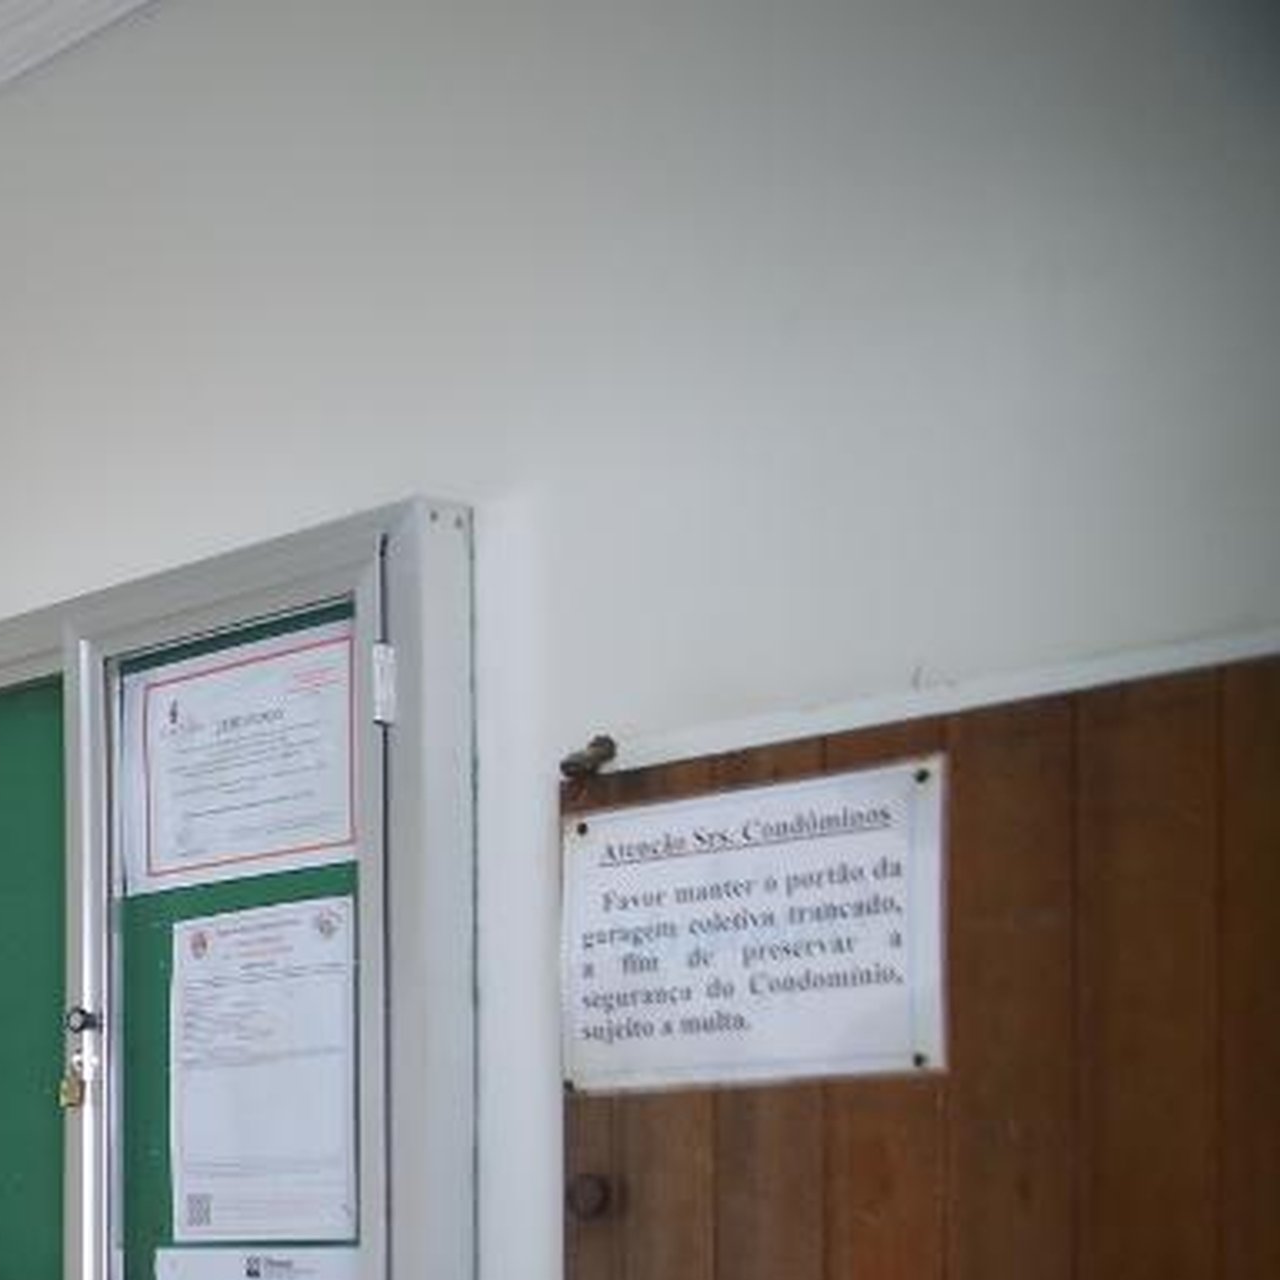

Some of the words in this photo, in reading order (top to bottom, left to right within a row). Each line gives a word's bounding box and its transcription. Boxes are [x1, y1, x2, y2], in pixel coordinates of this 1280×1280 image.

[600, 832, 687, 865] Atenção
[601, 885, 668, 912] Favor
[673, 877, 756, 904] manter
[763, 873, 779, 892] o
[784, 862, 865, 897] portão
[871, 855, 903, 880] da
[581, 922, 678, 949] garagem
[687, 904, 775, 936] coletiva
[582, 961, 595, 980] a
[621, 952, 660, 975] fim
[687, 945, 715, 970] de
[741, 934, 857, 967] preservar
[889, 932, 903, 949] a
[581, 984, 694, 1015] segurança
[705, 976, 736, 1000] do
[580, 1012, 656, 1045] sujeito
[659, 1018, 674, 1035] a
[678, 1007, 752, 1034] multa.
